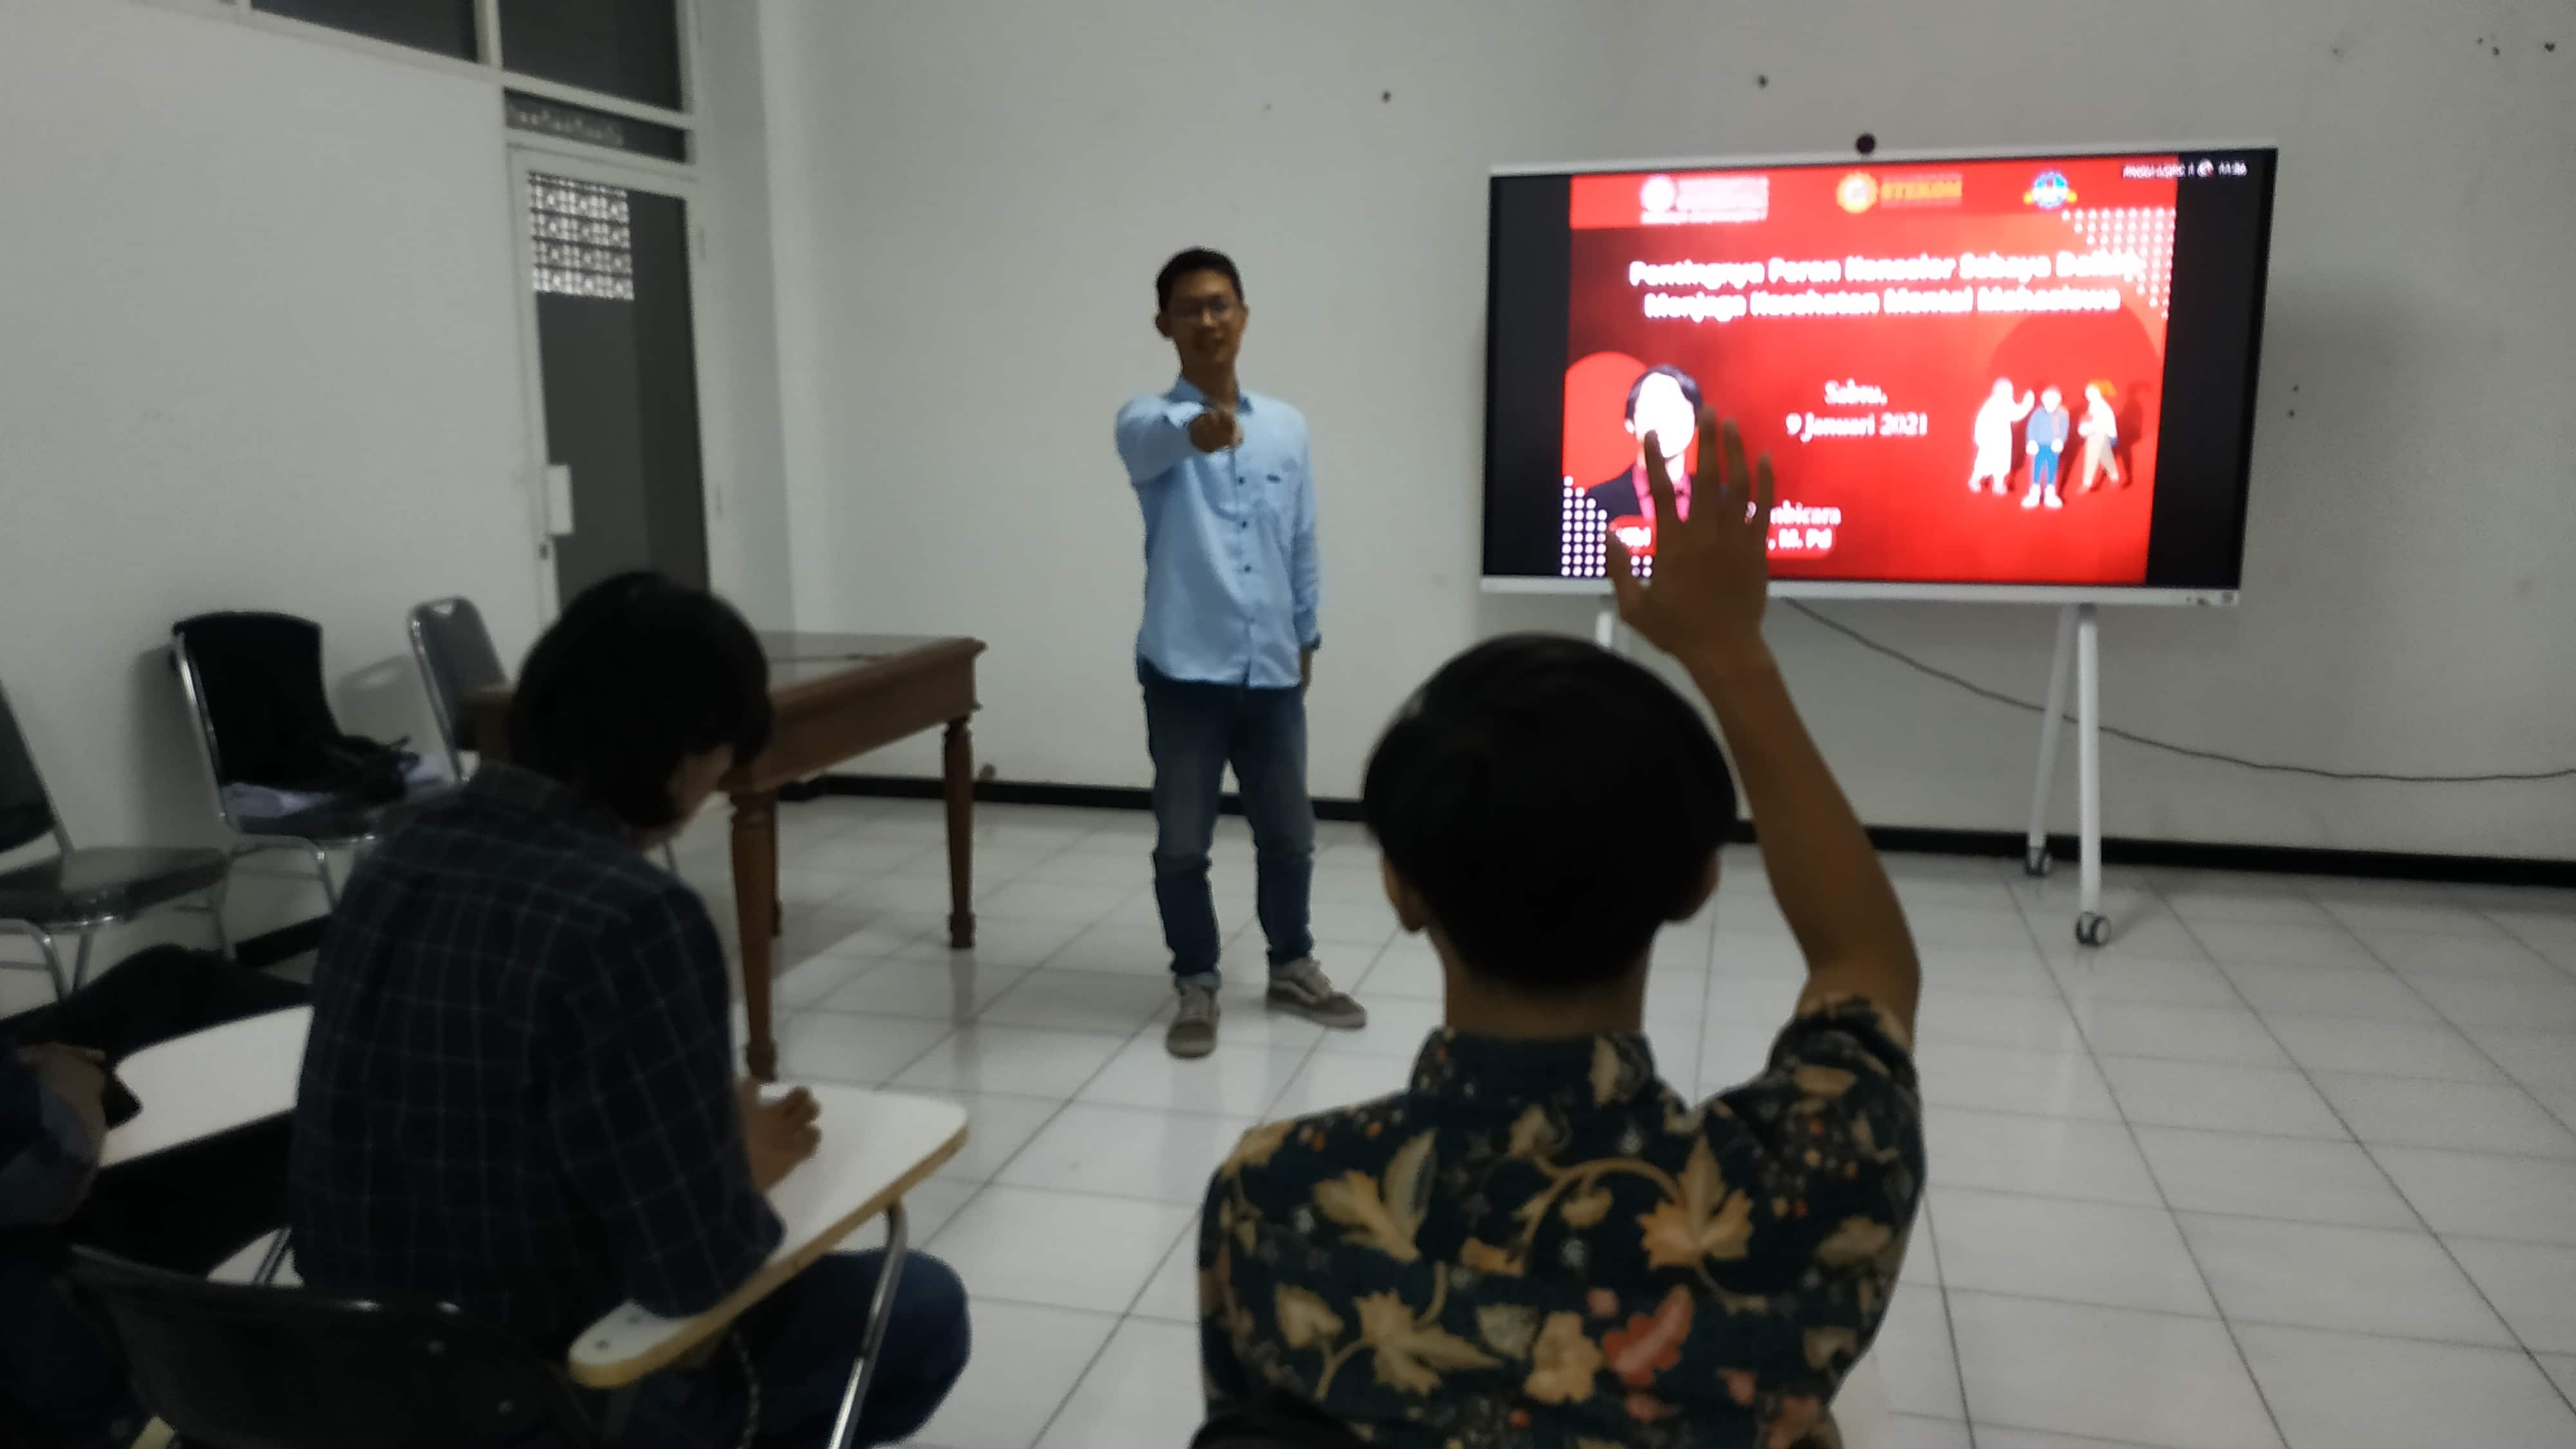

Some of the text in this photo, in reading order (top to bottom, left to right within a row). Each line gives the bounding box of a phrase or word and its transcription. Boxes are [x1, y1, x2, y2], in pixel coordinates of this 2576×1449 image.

[1629, 259, 1765, 289] Pentingnya
[1768, 257, 1841, 283] Peran
[1844, 252, 1956, 281] Konselor
[1959, 252, 2052, 283] Sebaya
[1644, 285, 2121, 323] Menjaga Kesehatan Mental Mahasiswa
[1785, 412, 1927, 443] 9 Januari 2021
